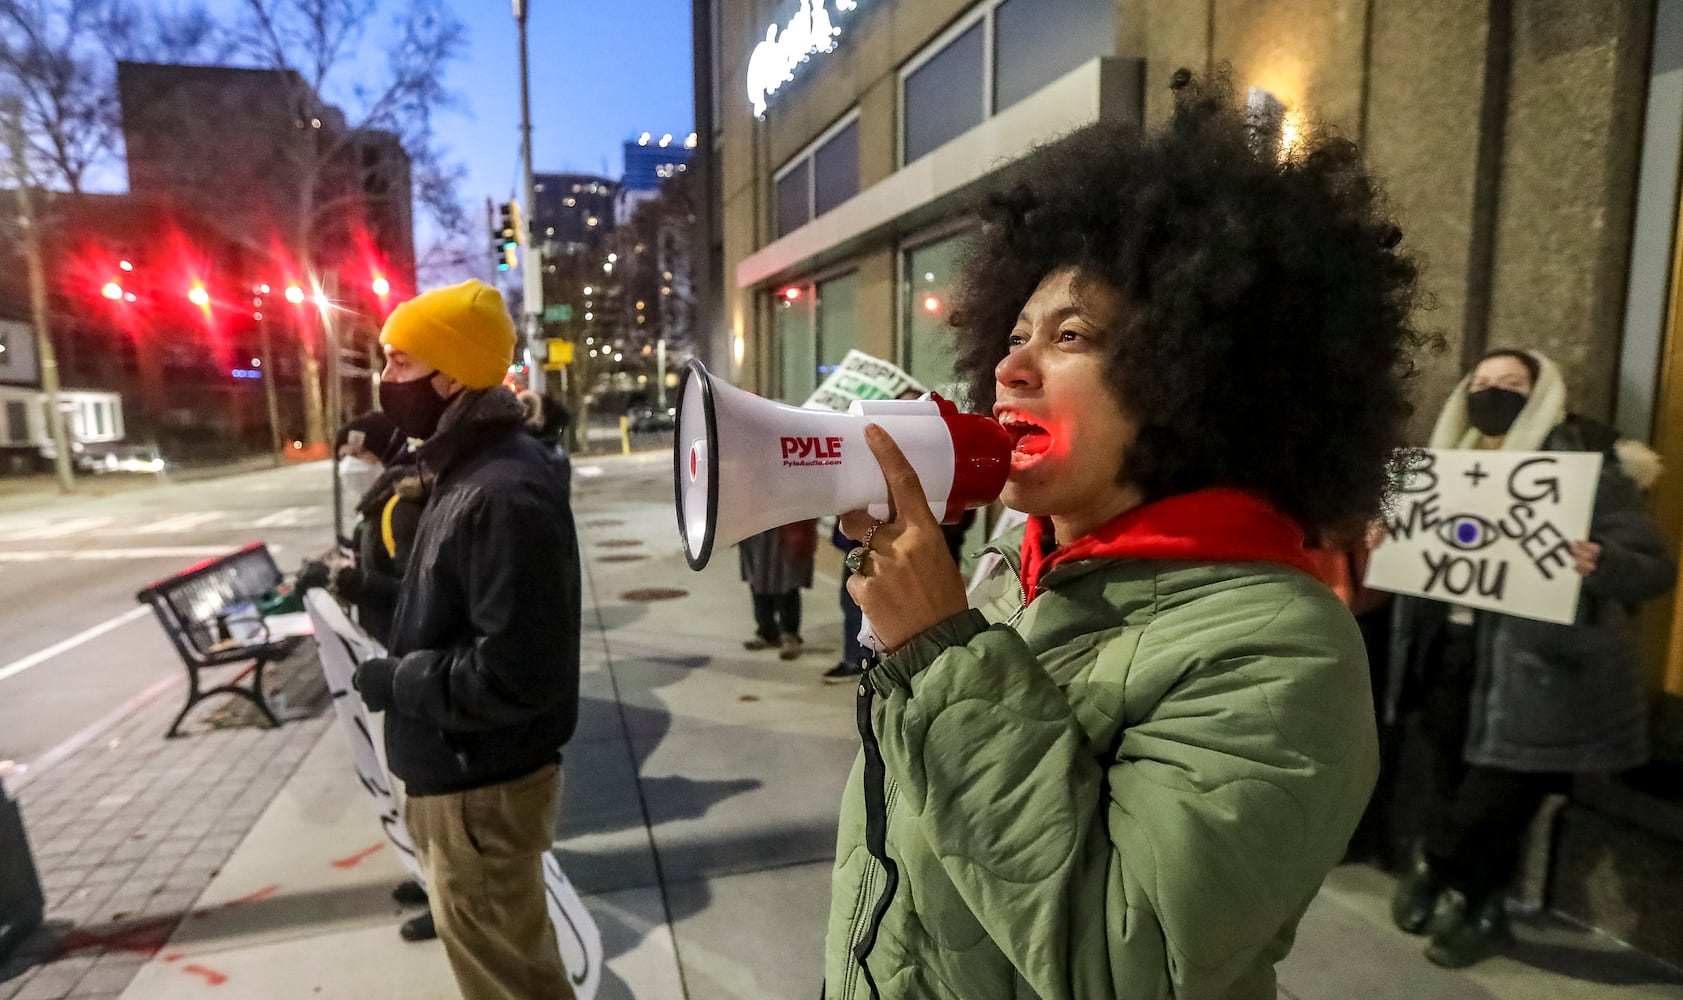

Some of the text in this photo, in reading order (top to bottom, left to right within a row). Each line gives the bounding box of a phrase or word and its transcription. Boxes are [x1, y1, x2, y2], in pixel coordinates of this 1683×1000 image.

[780, 437, 842, 458] PYLE
[1396, 452, 1560, 504] B + G
[1384, 494, 1574, 580] WE SEE
[1421, 550, 1508, 600] YOU
